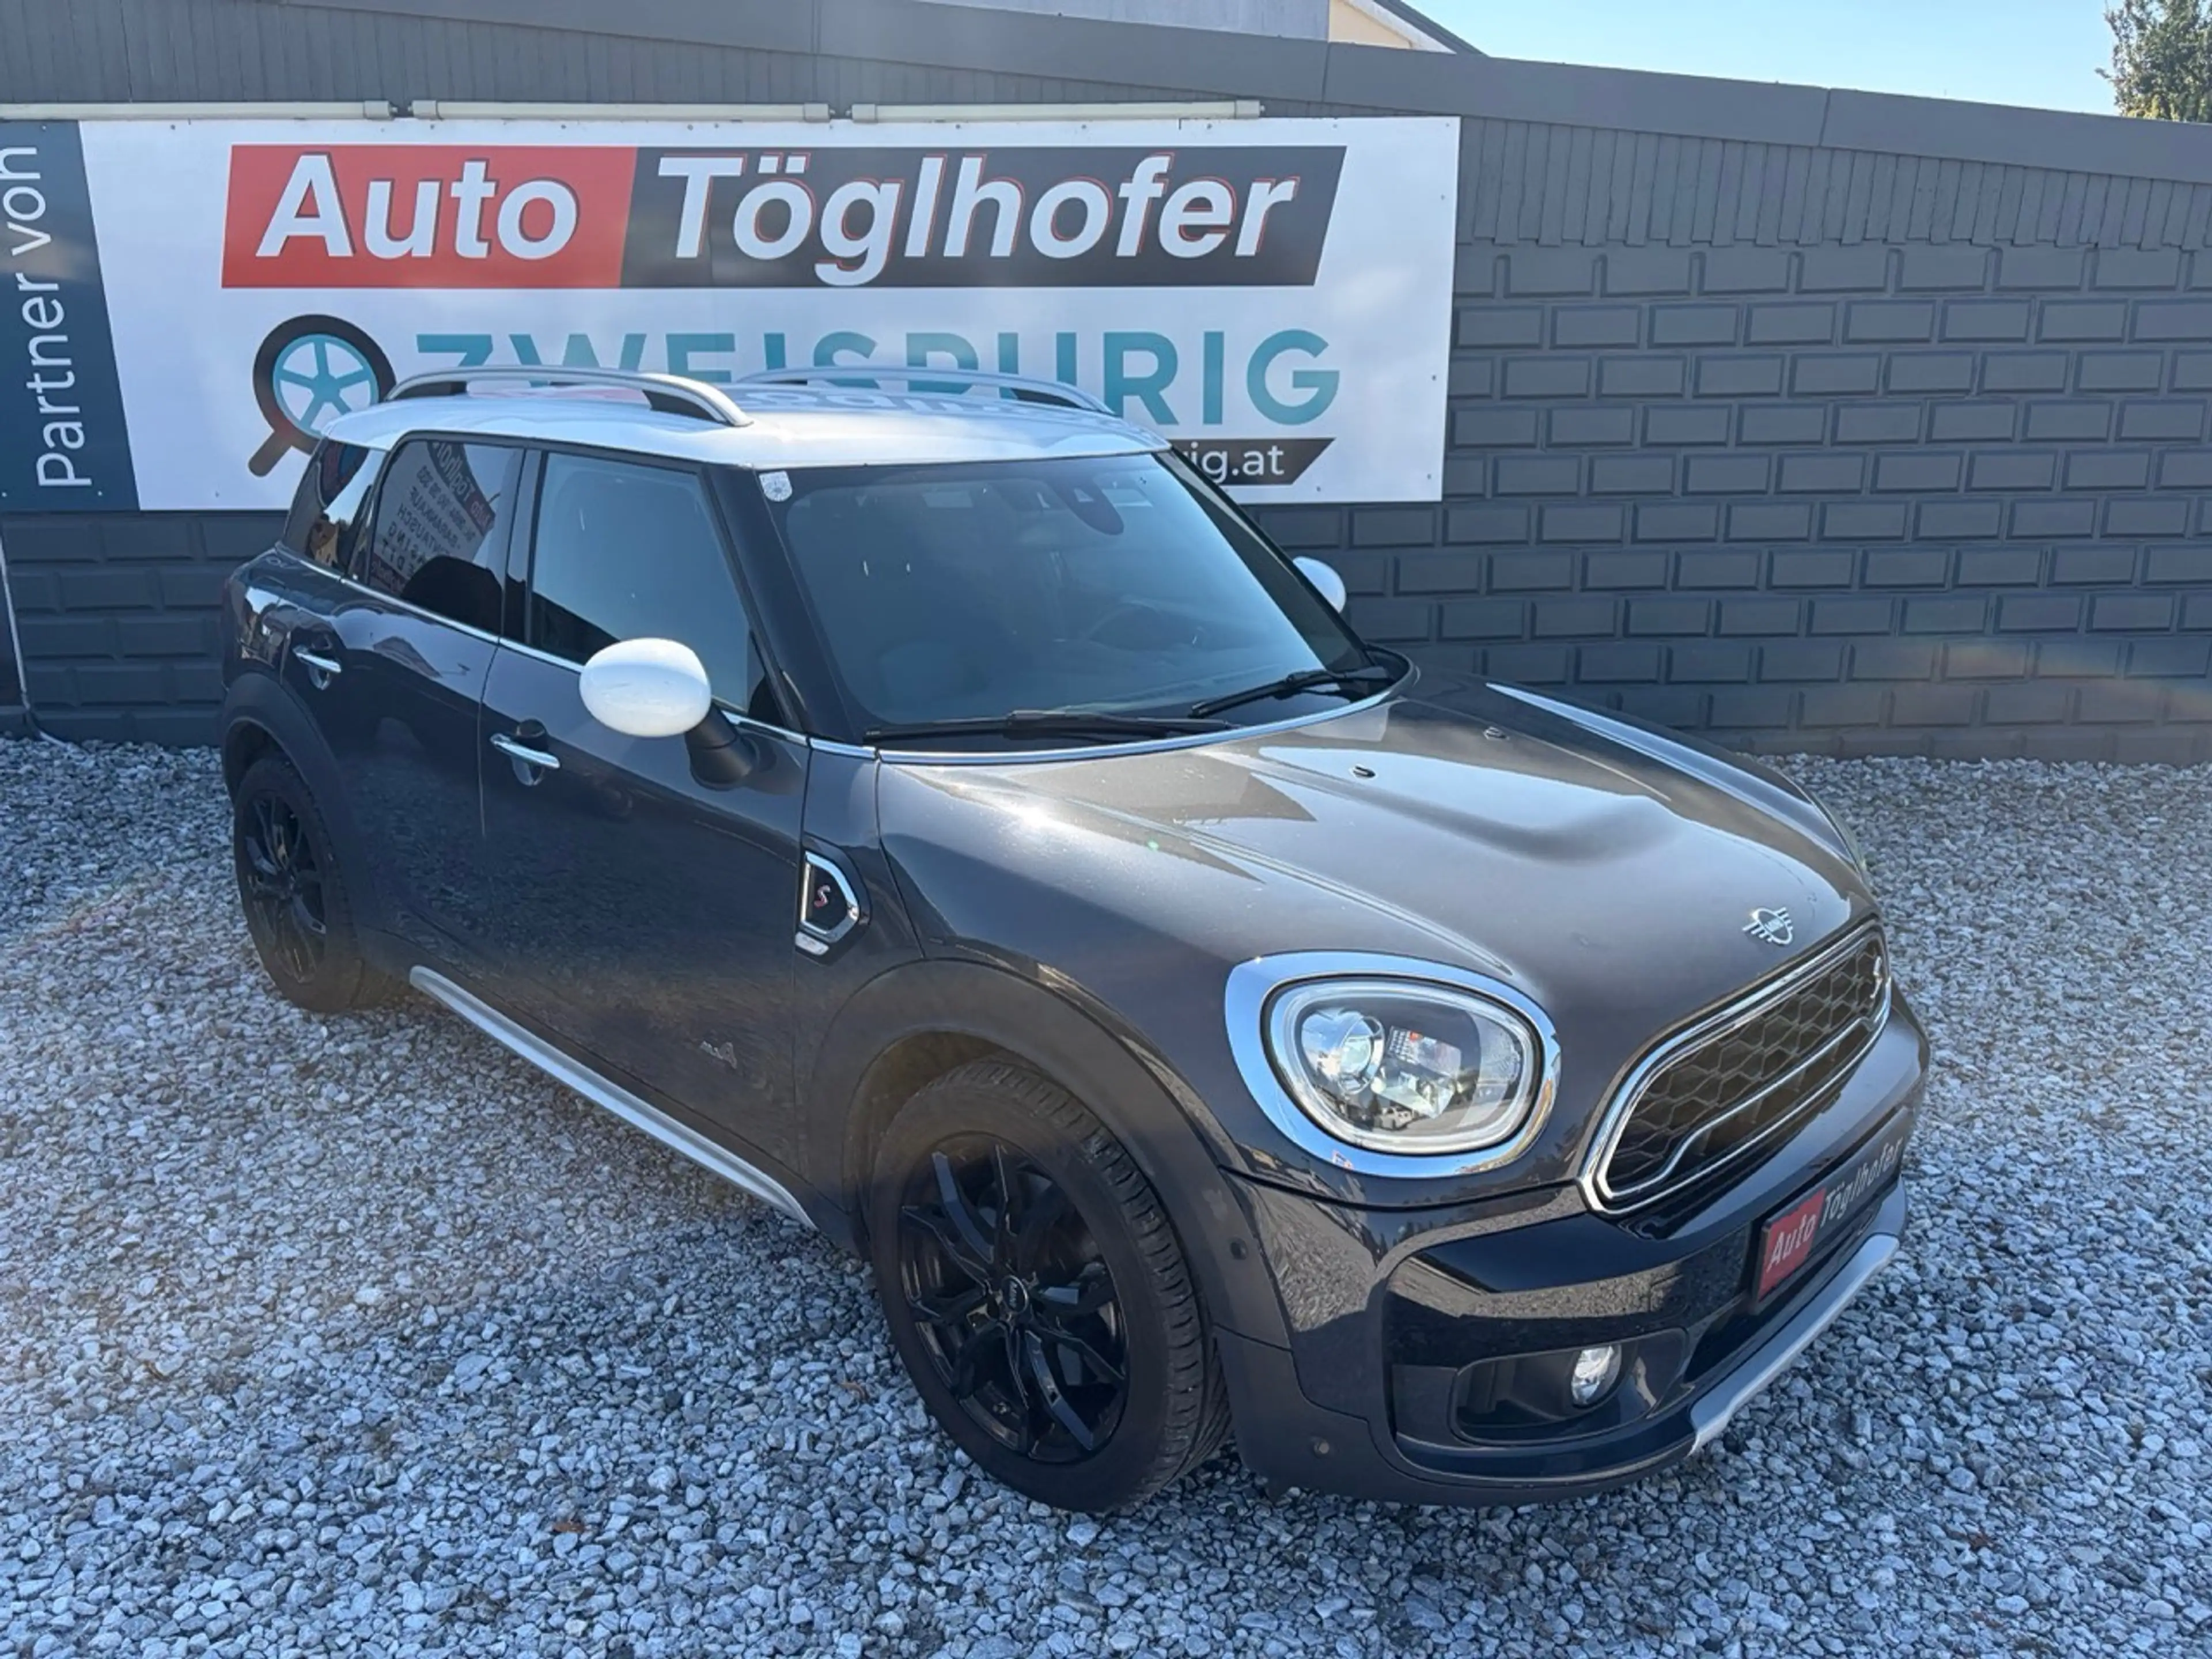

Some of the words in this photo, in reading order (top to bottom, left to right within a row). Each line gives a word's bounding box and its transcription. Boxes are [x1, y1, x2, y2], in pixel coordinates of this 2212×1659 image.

[0, 146, 52, 255] von
[255, 151, 579, 260] Auto
[657, 152, 1301, 286] Töglhofer
[16, 272, 92, 487] Partner
[1183, 441, 1285, 484] ig.at
[1766, 1214, 1817, 1273] Auto
[1820, 1137, 1903, 1229] Töglhofer
